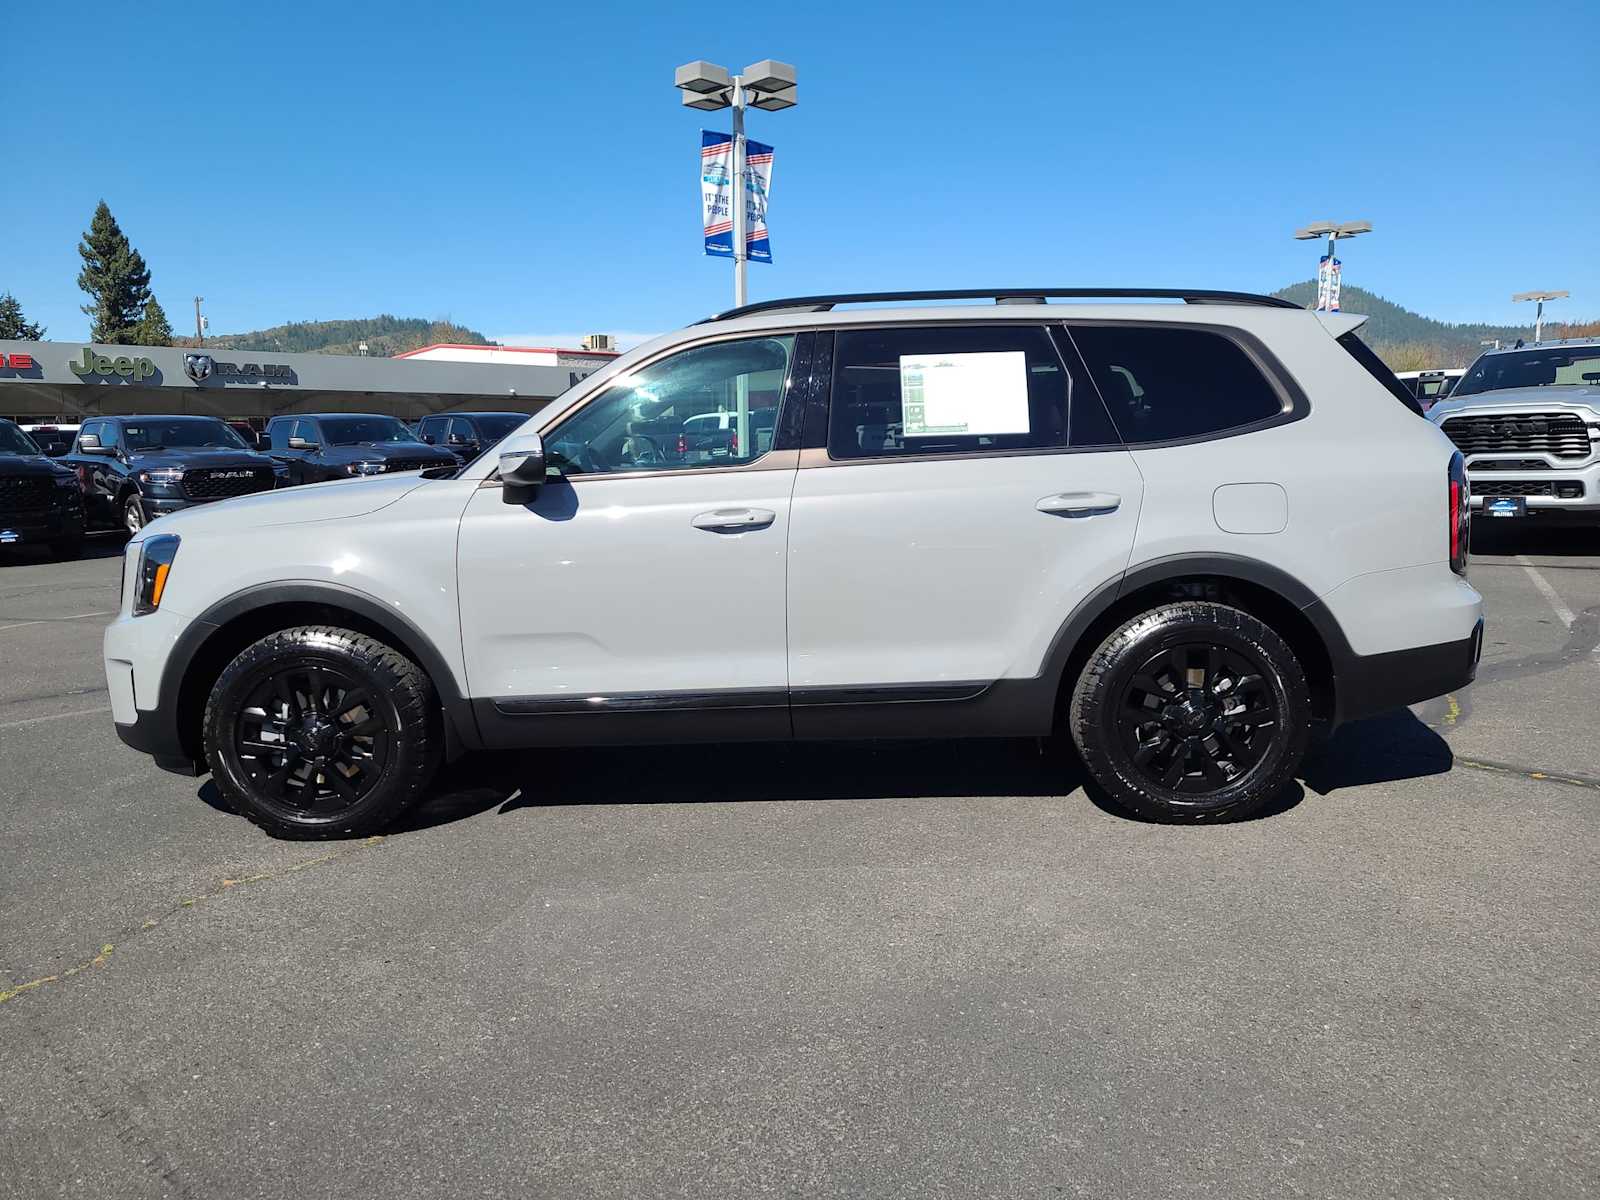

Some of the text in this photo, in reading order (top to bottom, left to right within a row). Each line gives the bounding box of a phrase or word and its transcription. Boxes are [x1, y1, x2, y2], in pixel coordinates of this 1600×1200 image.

[718, 194, 729, 205] THE
[707, 204, 729, 217] PEOPLE
[69, 347, 156, 382] Jeep
[216, 362, 292, 377] RAM
[209, 470, 255, 479] RAM
